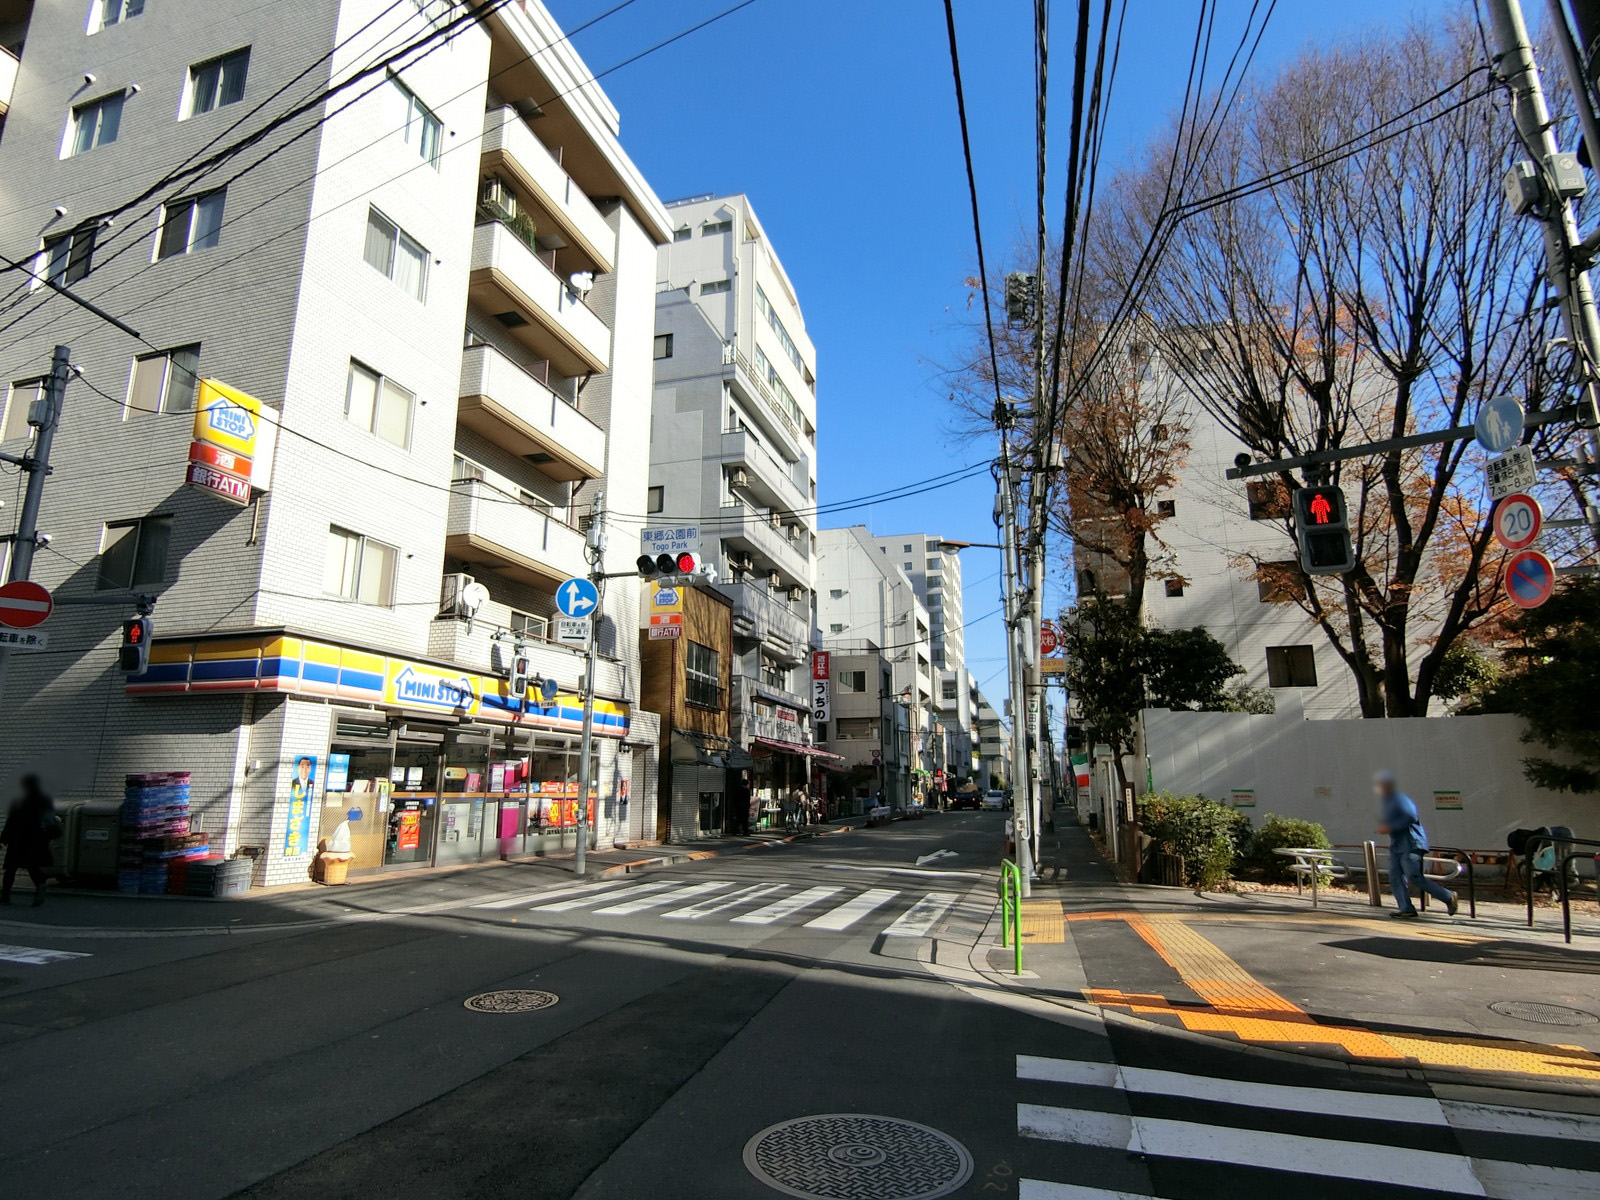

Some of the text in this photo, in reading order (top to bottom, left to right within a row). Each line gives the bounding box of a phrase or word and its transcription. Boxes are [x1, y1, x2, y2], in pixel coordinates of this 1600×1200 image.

[216, 416, 246, 434] STOP
[218, 408, 246, 425] MINI
[1486, 452, 1527, 475] 自転車を除く
[192, 467, 249, 500] 銀行ATM
[1503, 507, 1531, 538] 20
[643, 527, 697, 542] 東郷公園前
[652, 541, 688, 552] Togo Park
[651, 627, 680, 637] 銀行ATM
[1040, 634, 1055, 647] 火栓
[817, 655, 826, 677] 近江牛
[405, 680, 435, 699] MINI
[814, 682, 826, 720] うちの
